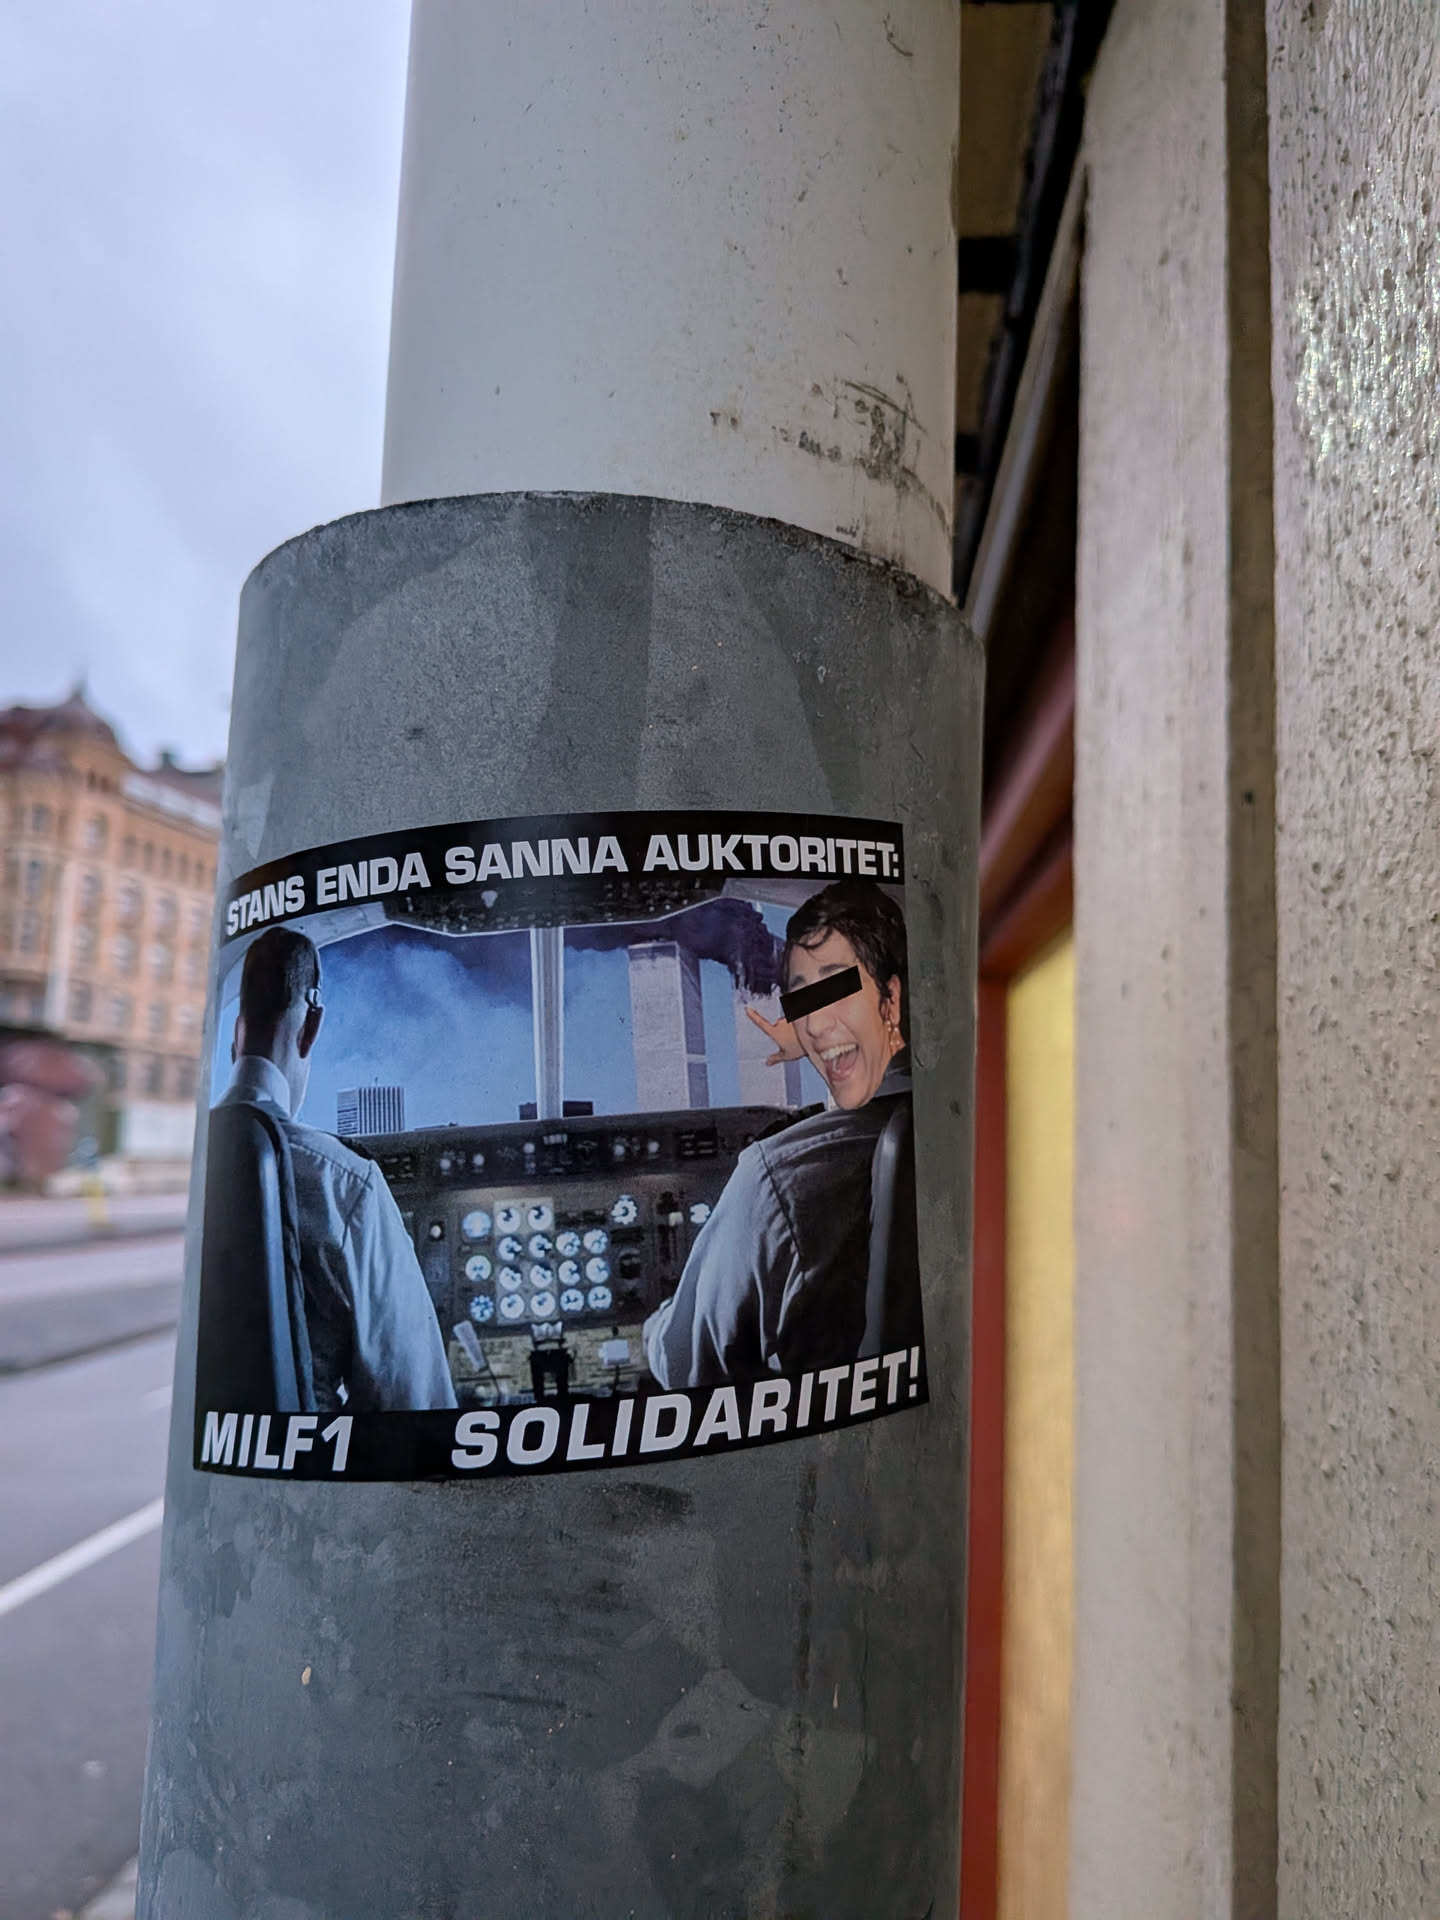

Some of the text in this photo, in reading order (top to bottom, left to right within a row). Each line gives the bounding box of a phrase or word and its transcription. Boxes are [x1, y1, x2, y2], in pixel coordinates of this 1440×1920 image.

[226, 833, 900, 936] STANS ENDA SANNA AUKTORITET:
[201, 1411, 354, 1471] MILF1
[451, 1345, 920, 1469] SOLIDARITET!
